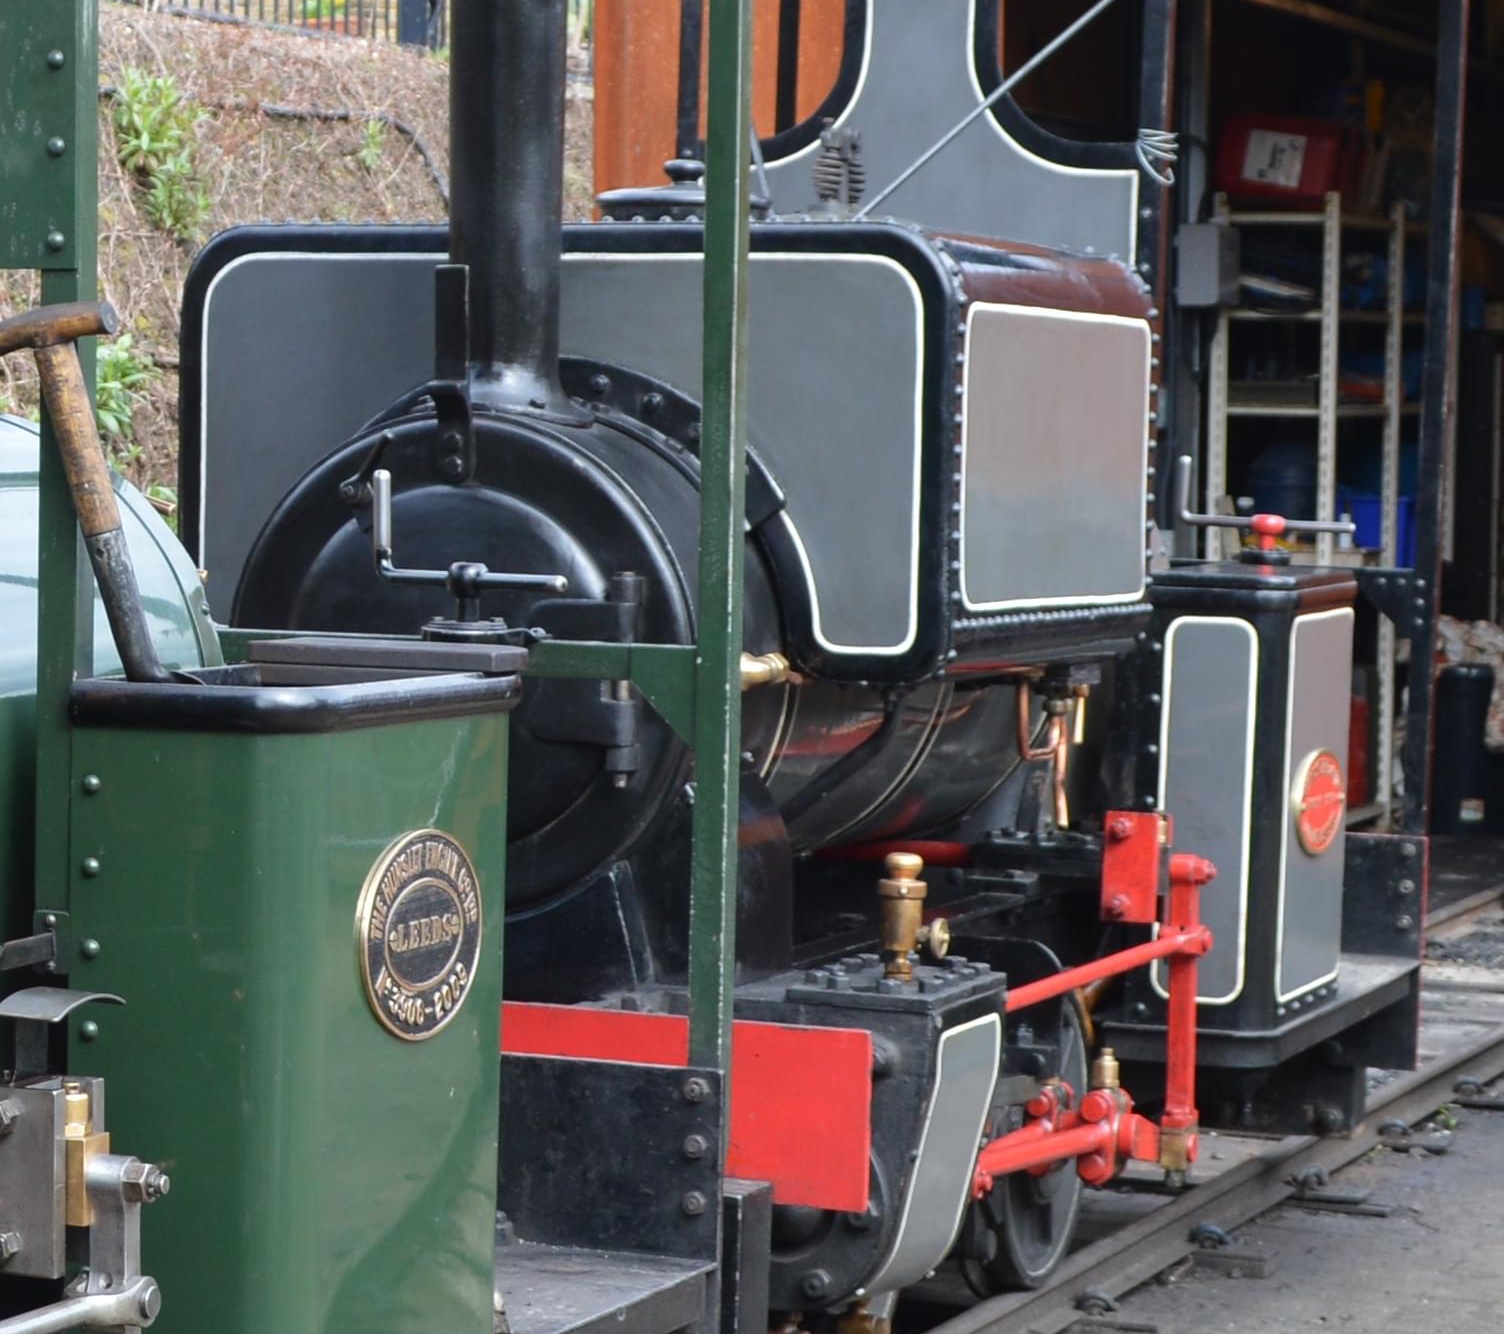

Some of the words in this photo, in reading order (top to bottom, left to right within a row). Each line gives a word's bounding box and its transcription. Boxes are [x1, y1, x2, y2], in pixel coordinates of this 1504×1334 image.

[371, 895, 388, 939] THE
[382, 843, 423, 904] HUNSLET
[397, 914, 451, 952] LEEDS
